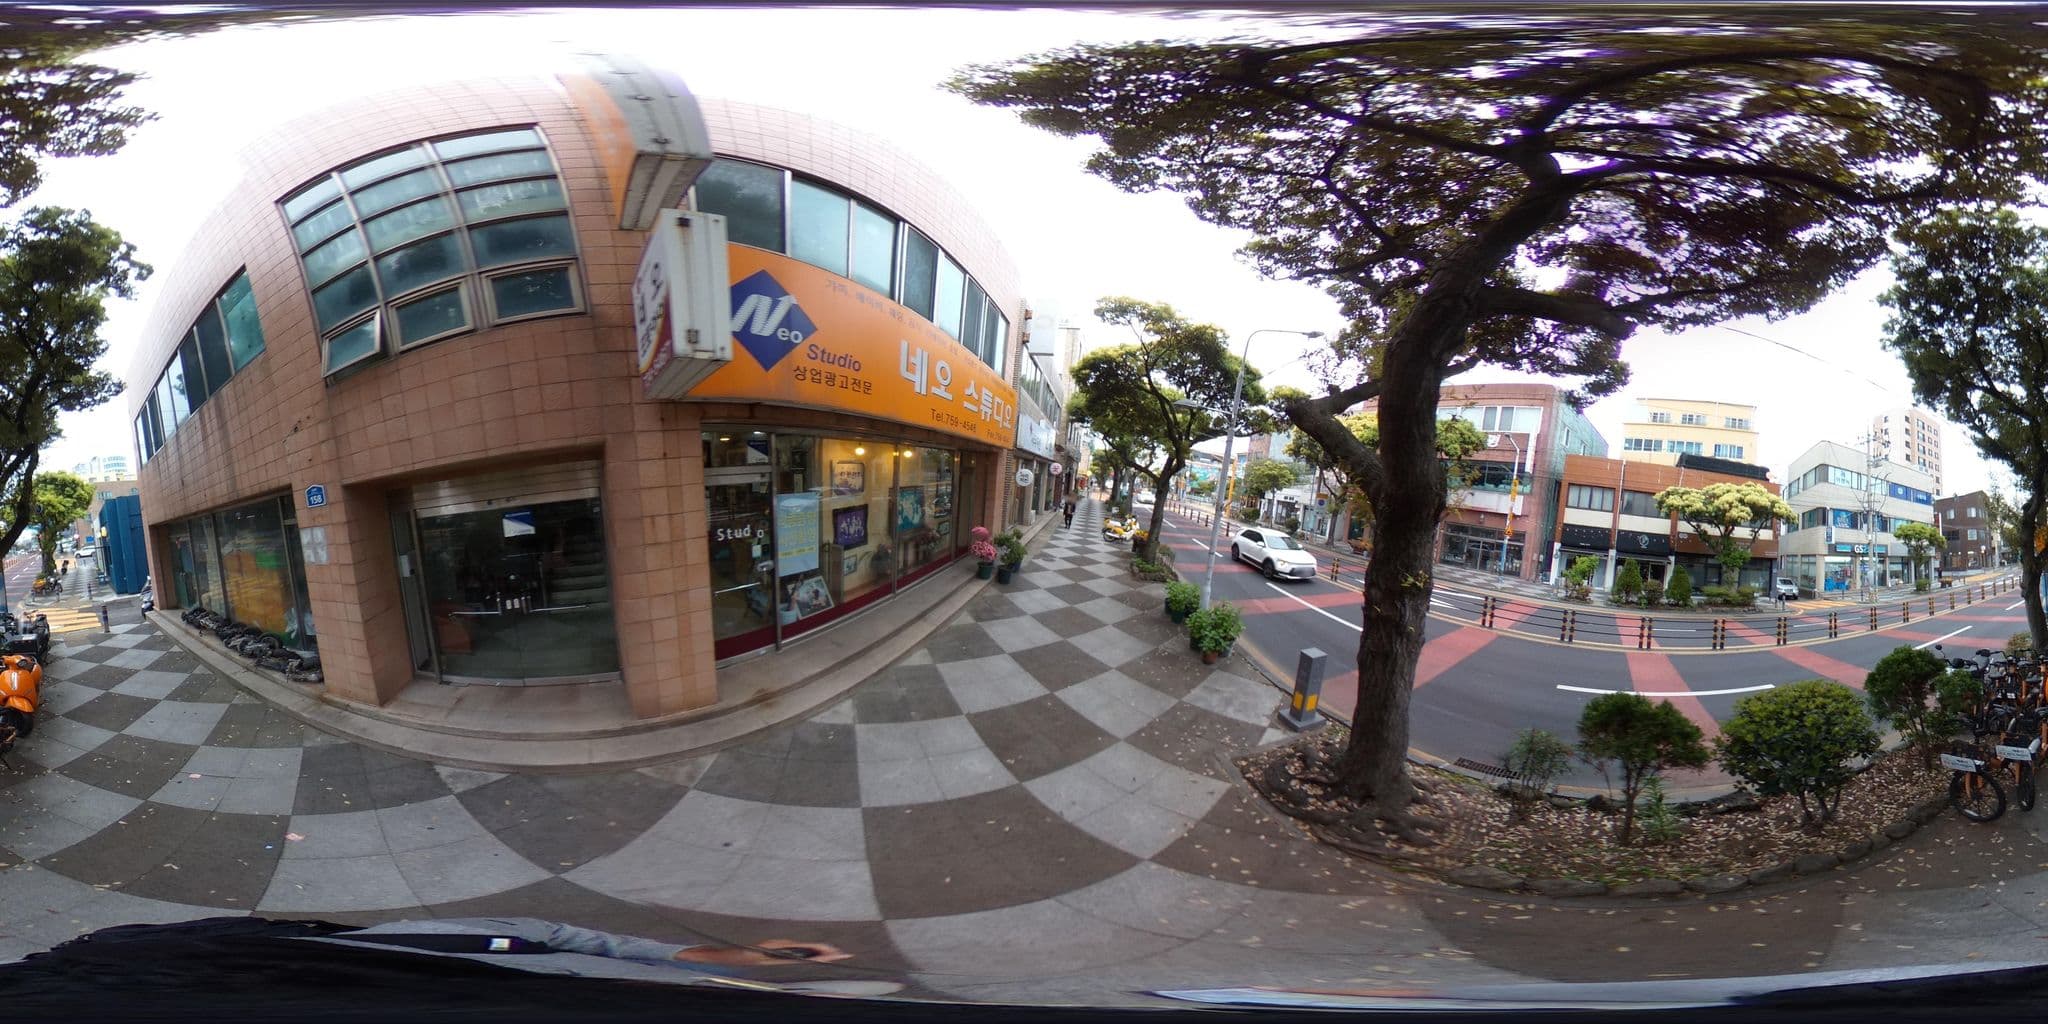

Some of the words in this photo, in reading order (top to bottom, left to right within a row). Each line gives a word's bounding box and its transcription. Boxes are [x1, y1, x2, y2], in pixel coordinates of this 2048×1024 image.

[730, 293, 804, 344] Neo
[807, 343, 862, 372] Studio
[793, 365, 873, 395] 상업광고전문
[900, 340, 953, 401] 네오
[963, 379, 1013, 429] 스튜디오
[310, 495, 323, 504] 158
